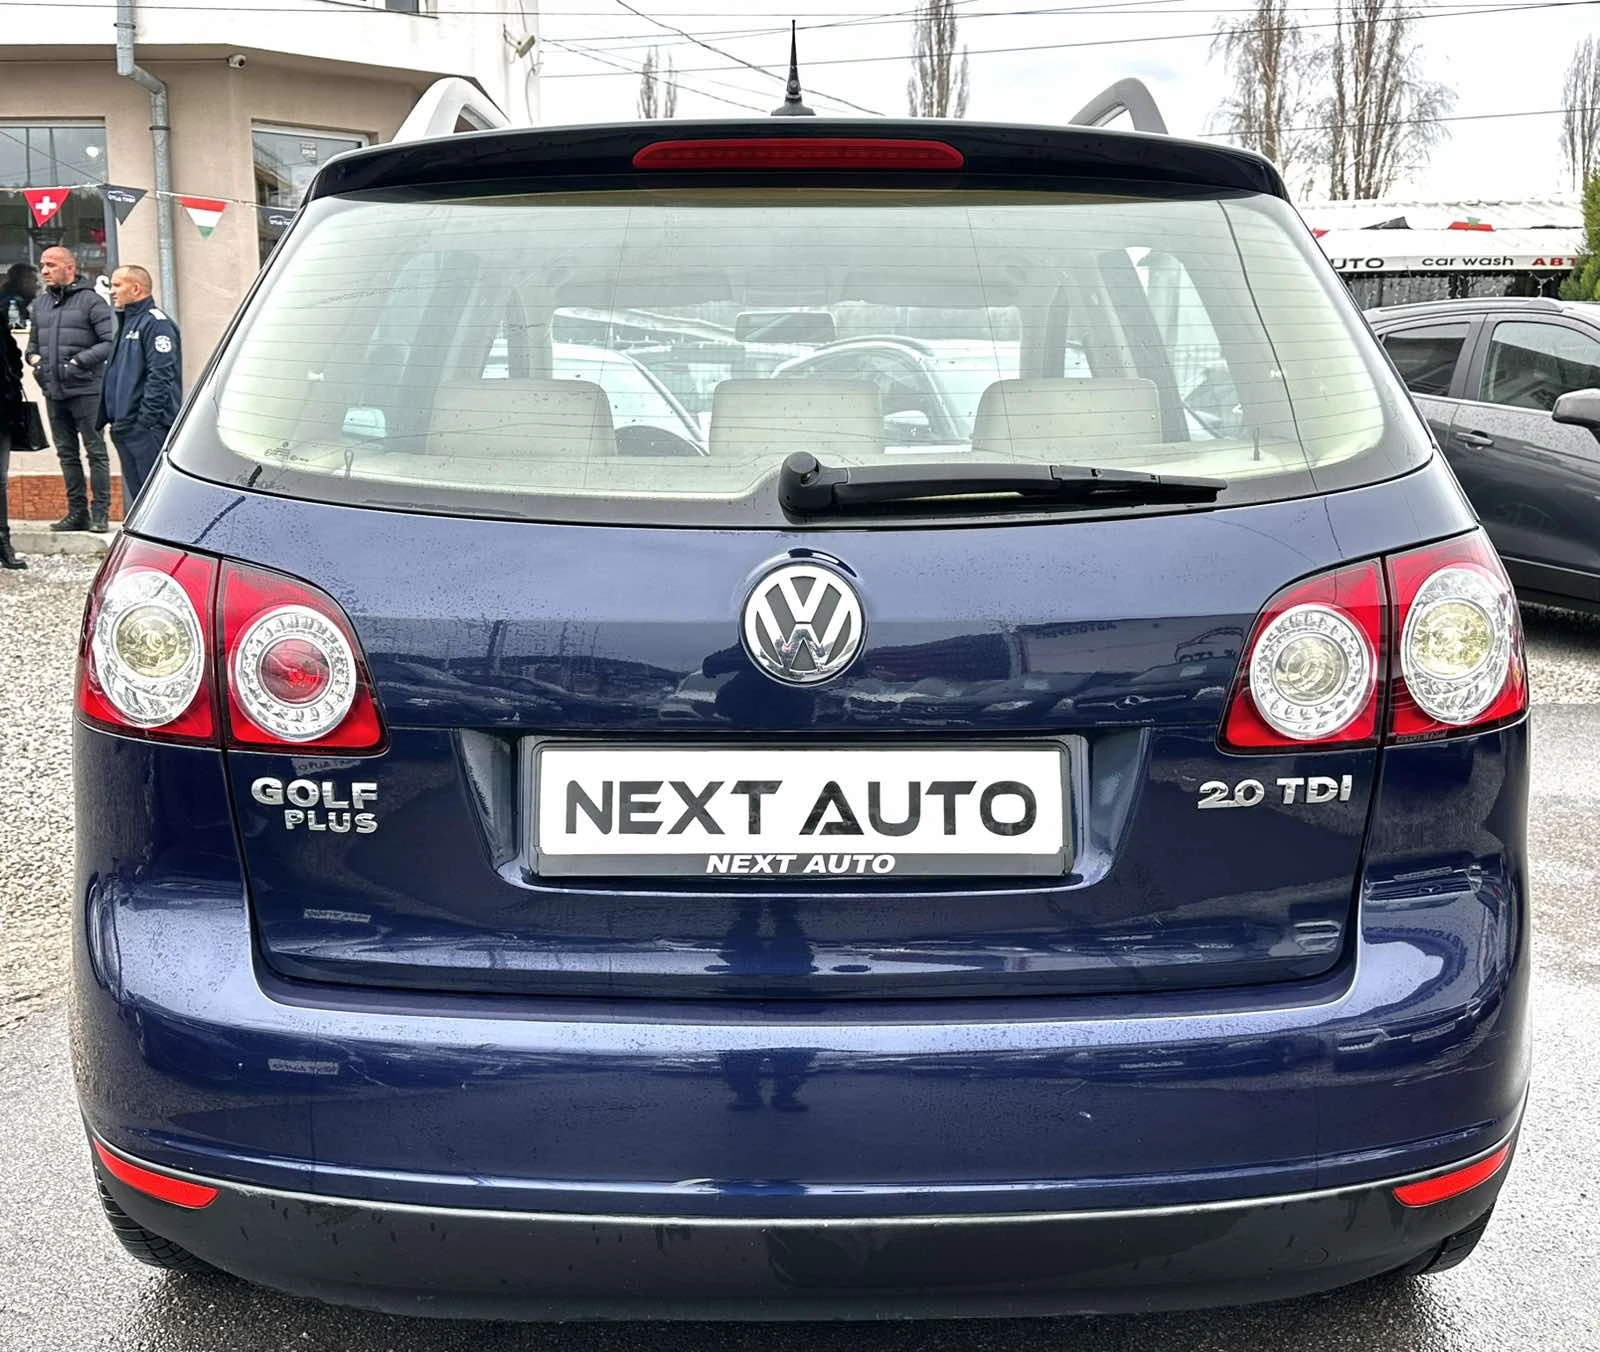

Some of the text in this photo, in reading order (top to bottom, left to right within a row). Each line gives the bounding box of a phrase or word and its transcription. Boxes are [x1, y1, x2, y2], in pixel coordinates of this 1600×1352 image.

[1330, 257, 1385, 270] UTO
[1421, 256, 1514, 266] car wash
[1531, 257, 1577, 266] АВТ
[251, 776, 378, 809] GOLF
[1276, 775, 1353, 805] TDI
[565, 779, 1038, 837] NEXT AUTO
[284, 809, 379, 834] PLUS
[705, 854, 896, 874] NEXT AUTO
